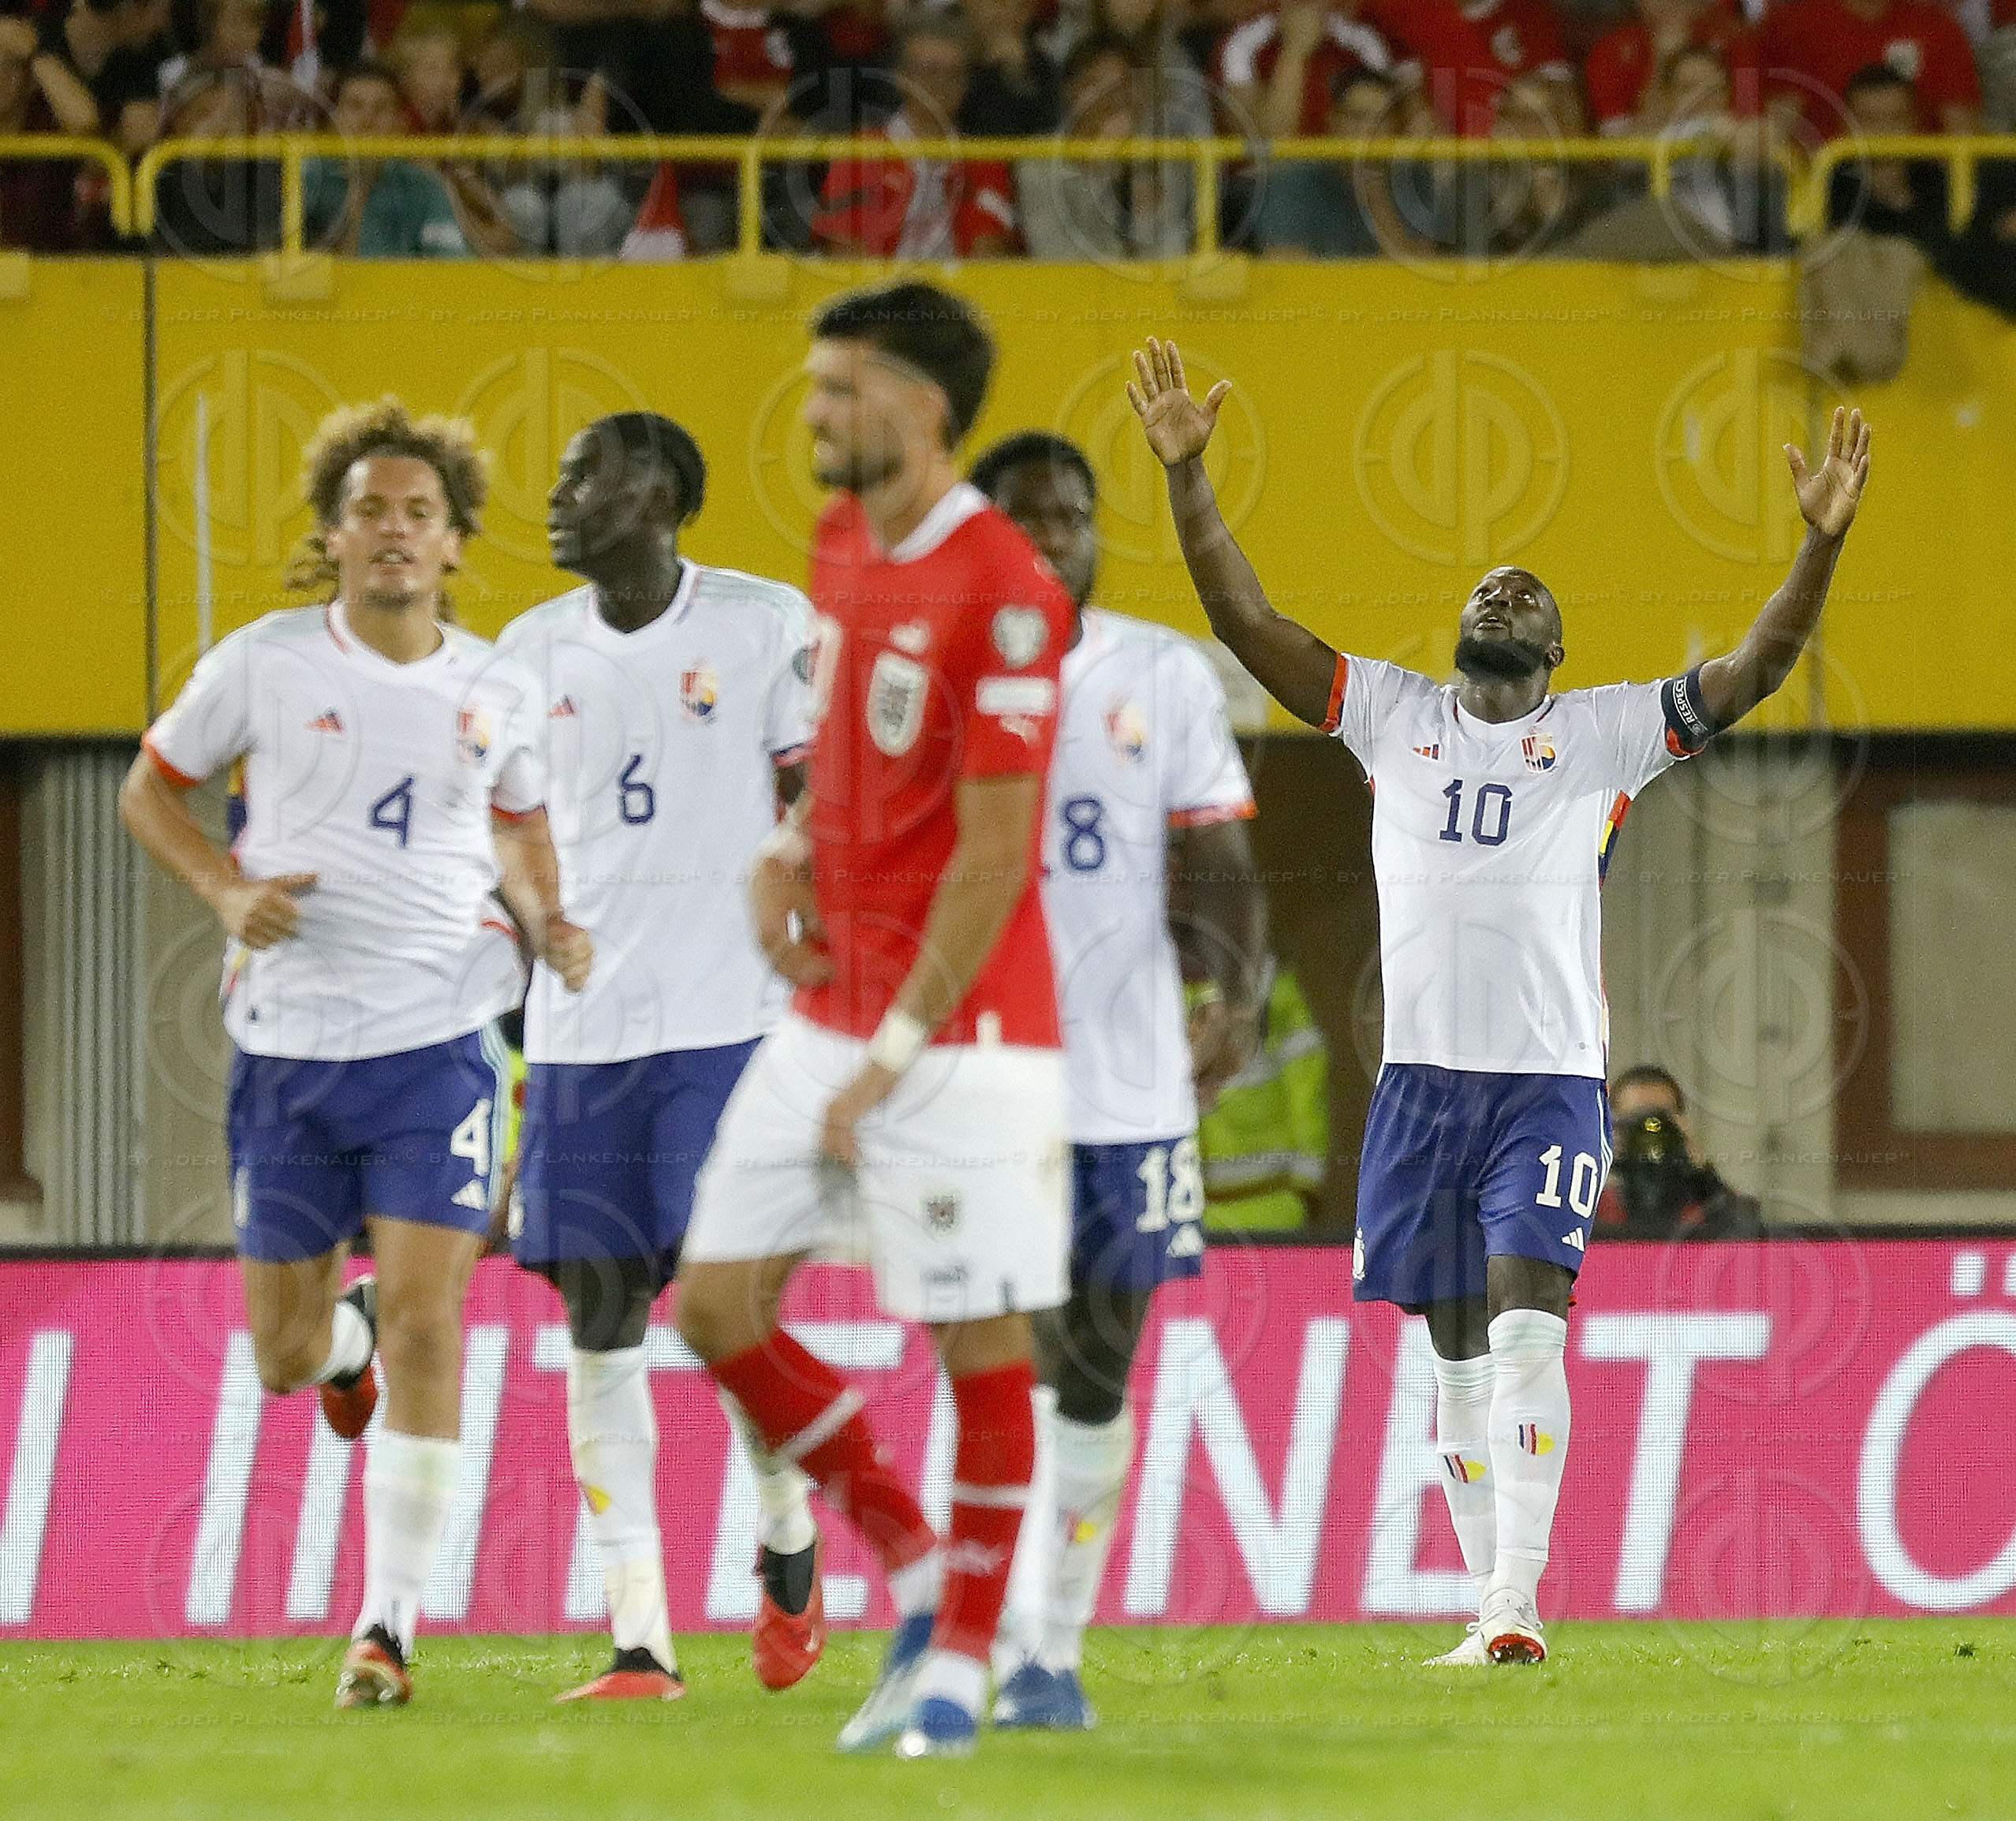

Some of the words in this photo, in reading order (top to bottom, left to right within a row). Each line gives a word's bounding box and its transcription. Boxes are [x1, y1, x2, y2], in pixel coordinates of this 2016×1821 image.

[369, 774, 414, 849] 4
[618, 753, 655, 826] 6
[1439, 778, 1513, 847] 10
[1043, 797, 1107, 872] 8
[450, 1097, 494, 1177] 4
[1136, 1137, 1206, 1233] 18
[1535, 1144, 1600, 1219] 10
[184, 1313, 1771, 1625] INTENET
